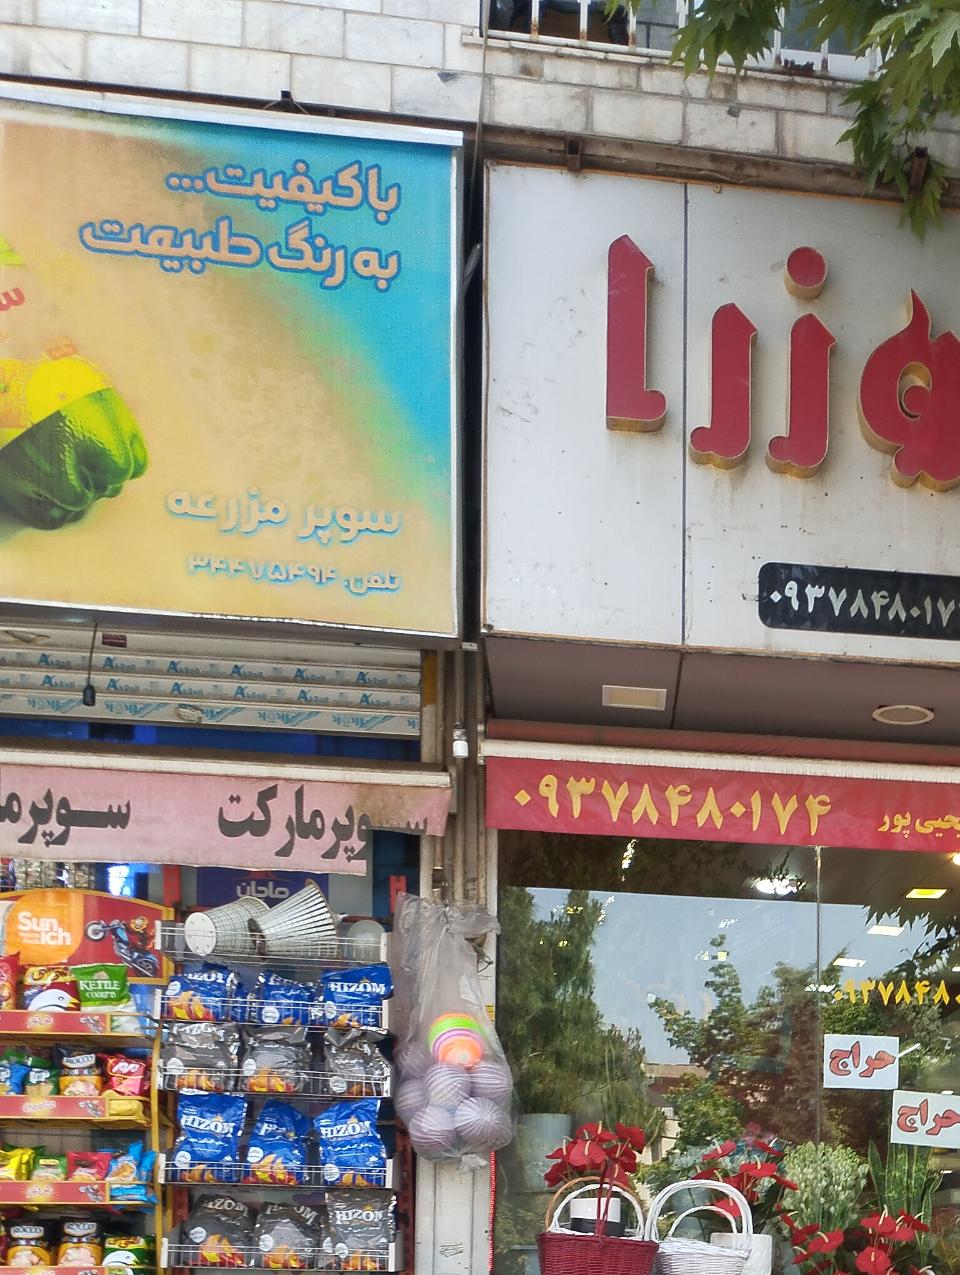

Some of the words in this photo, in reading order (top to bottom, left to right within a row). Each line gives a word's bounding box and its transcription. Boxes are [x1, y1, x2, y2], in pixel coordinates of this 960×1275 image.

[79, 215, 263, 275] طبیعت
[266, 216, 348, 290] رنگ
[353, 248, 400, 292] به
[166, 488, 288, 535] مزرعه
[298, 502, 400, 543] سوپر
[514, 774, 832, 836] ۰۹۳۷۸۴۸۰۱۷۴
[878, 811, 912, 839] پور
[79, 980, 120, 991] KETTLE
[329, 981, 386, 995] HIZOM
[829, 1040, 897, 1079] حراج
[181, 1114, 236, 1138] HIZOM
[320, 1119, 374, 1139] HIZOM
